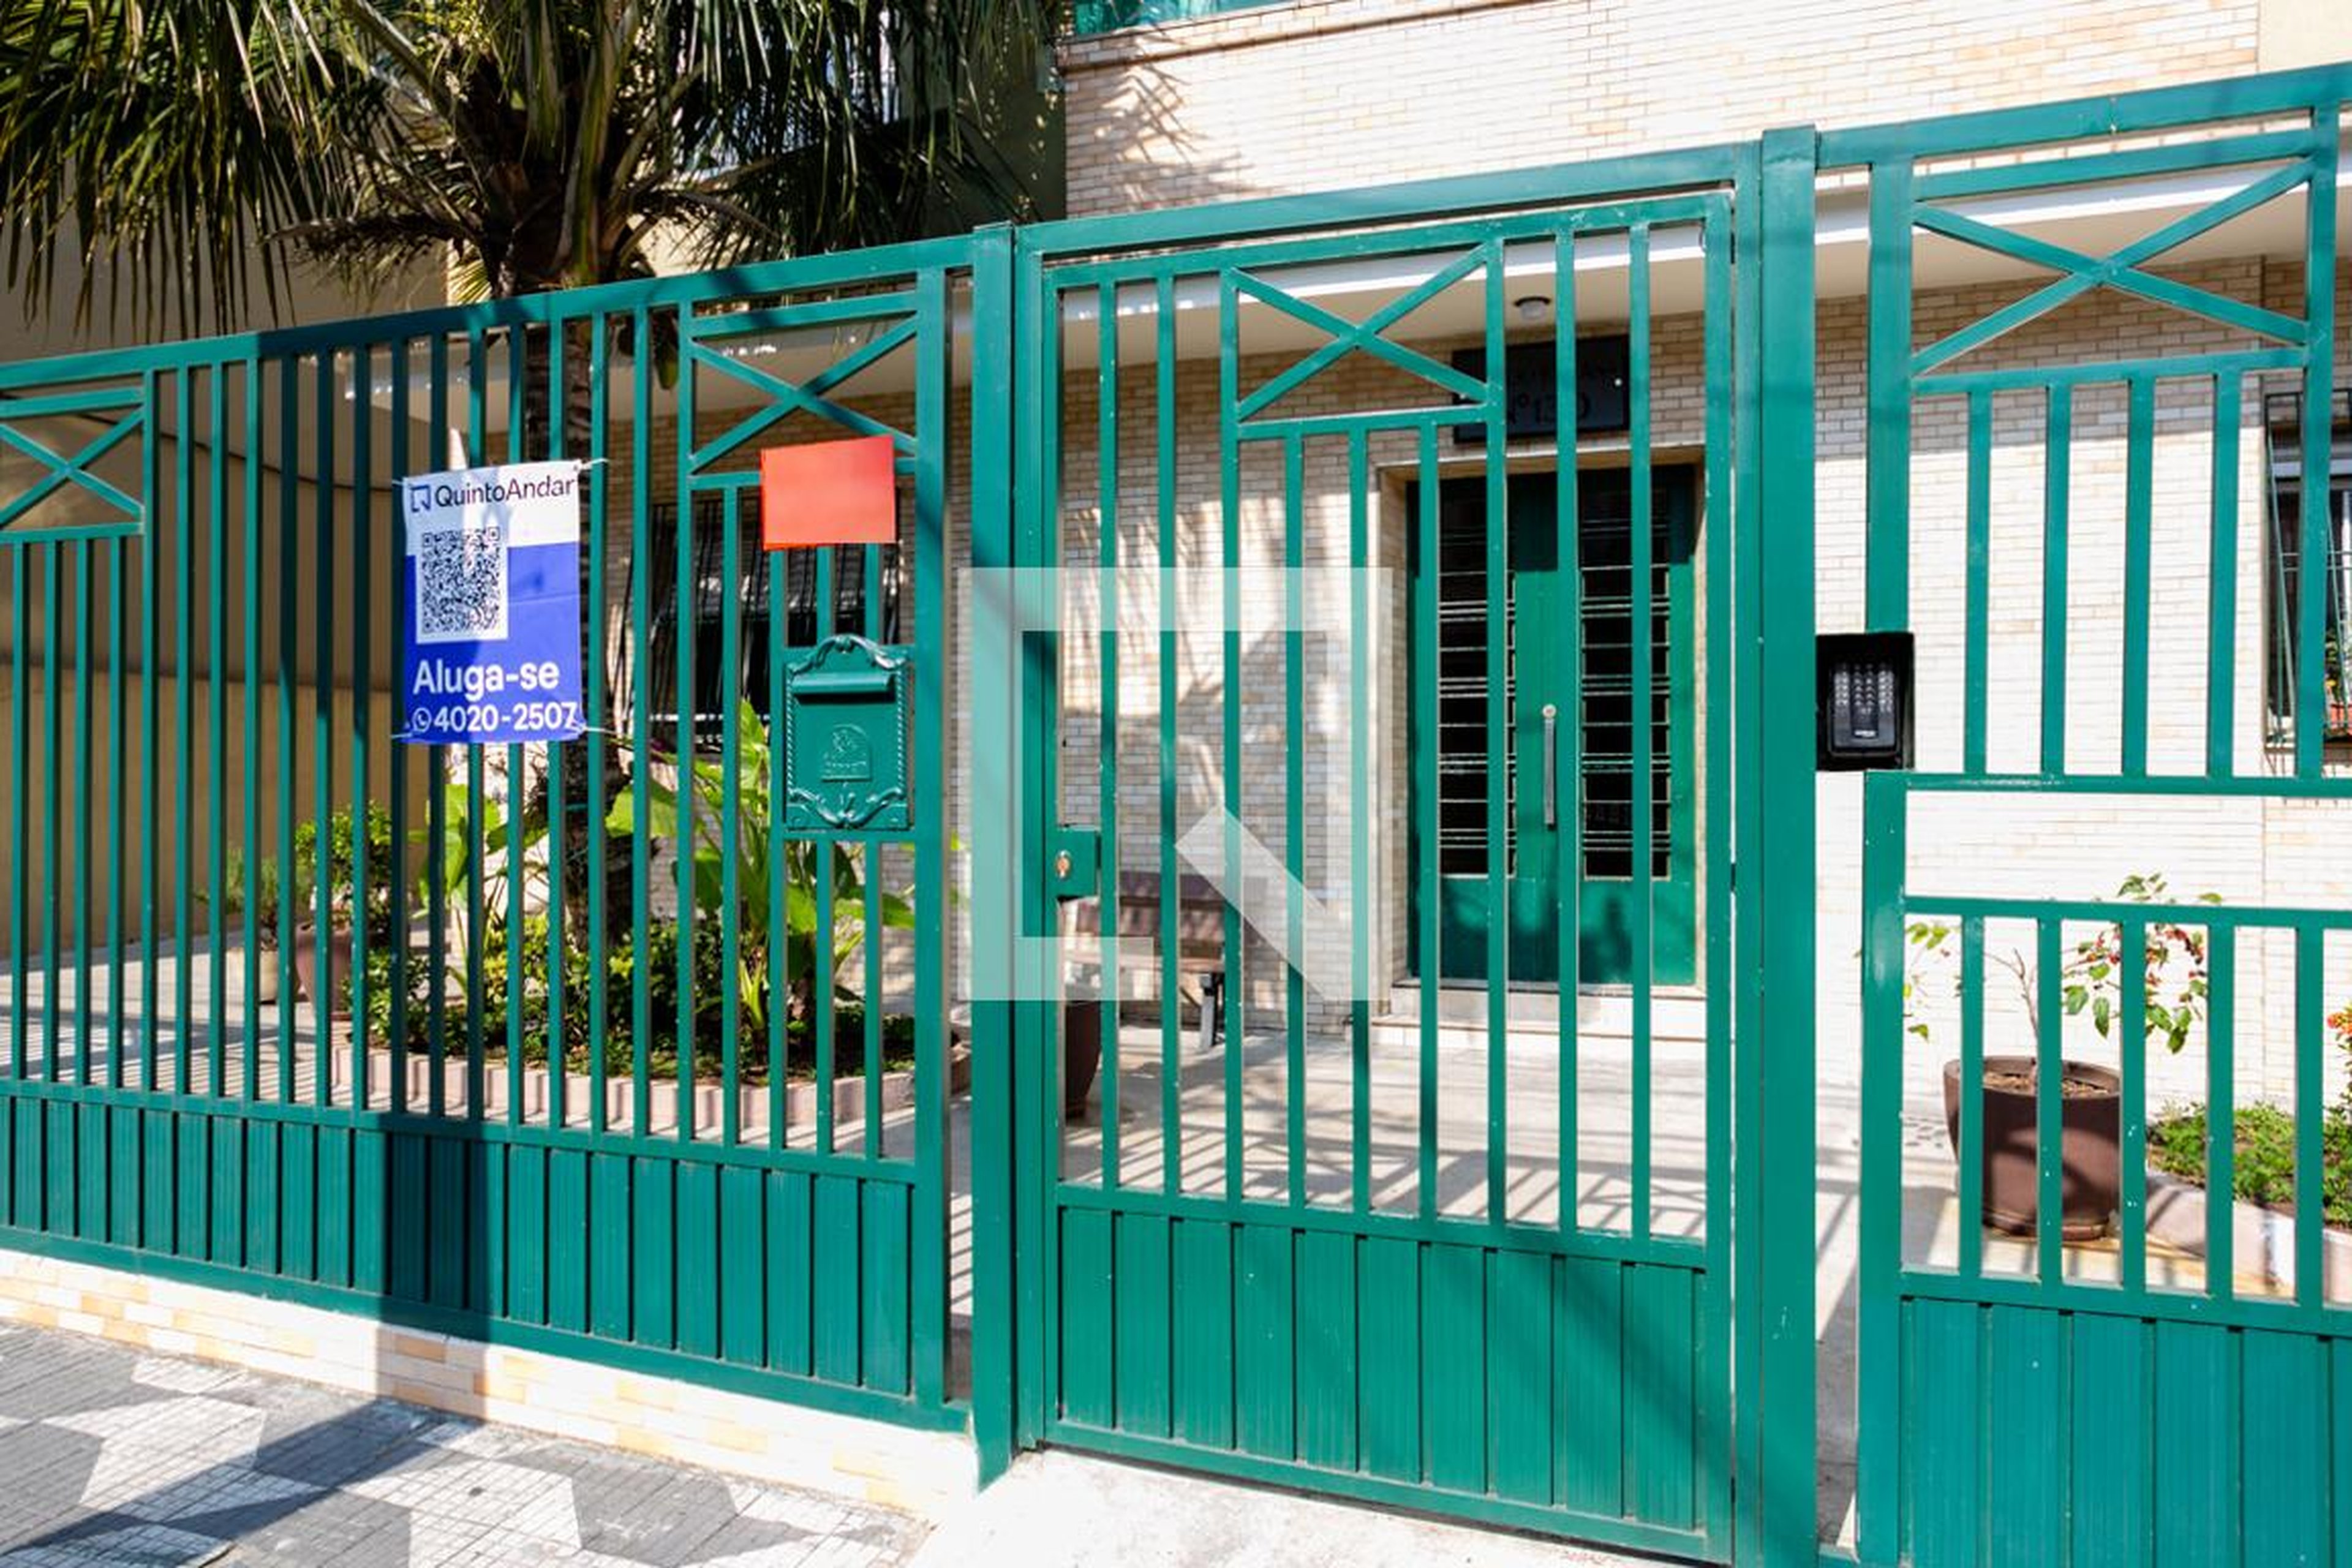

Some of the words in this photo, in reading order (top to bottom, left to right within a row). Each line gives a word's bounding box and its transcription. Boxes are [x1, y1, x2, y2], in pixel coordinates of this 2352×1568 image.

[435, 475, 574, 508] QuintoAndar
[413, 659, 559, 702] Aluga-se
[434, 702, 578, 733] 4020-2507
